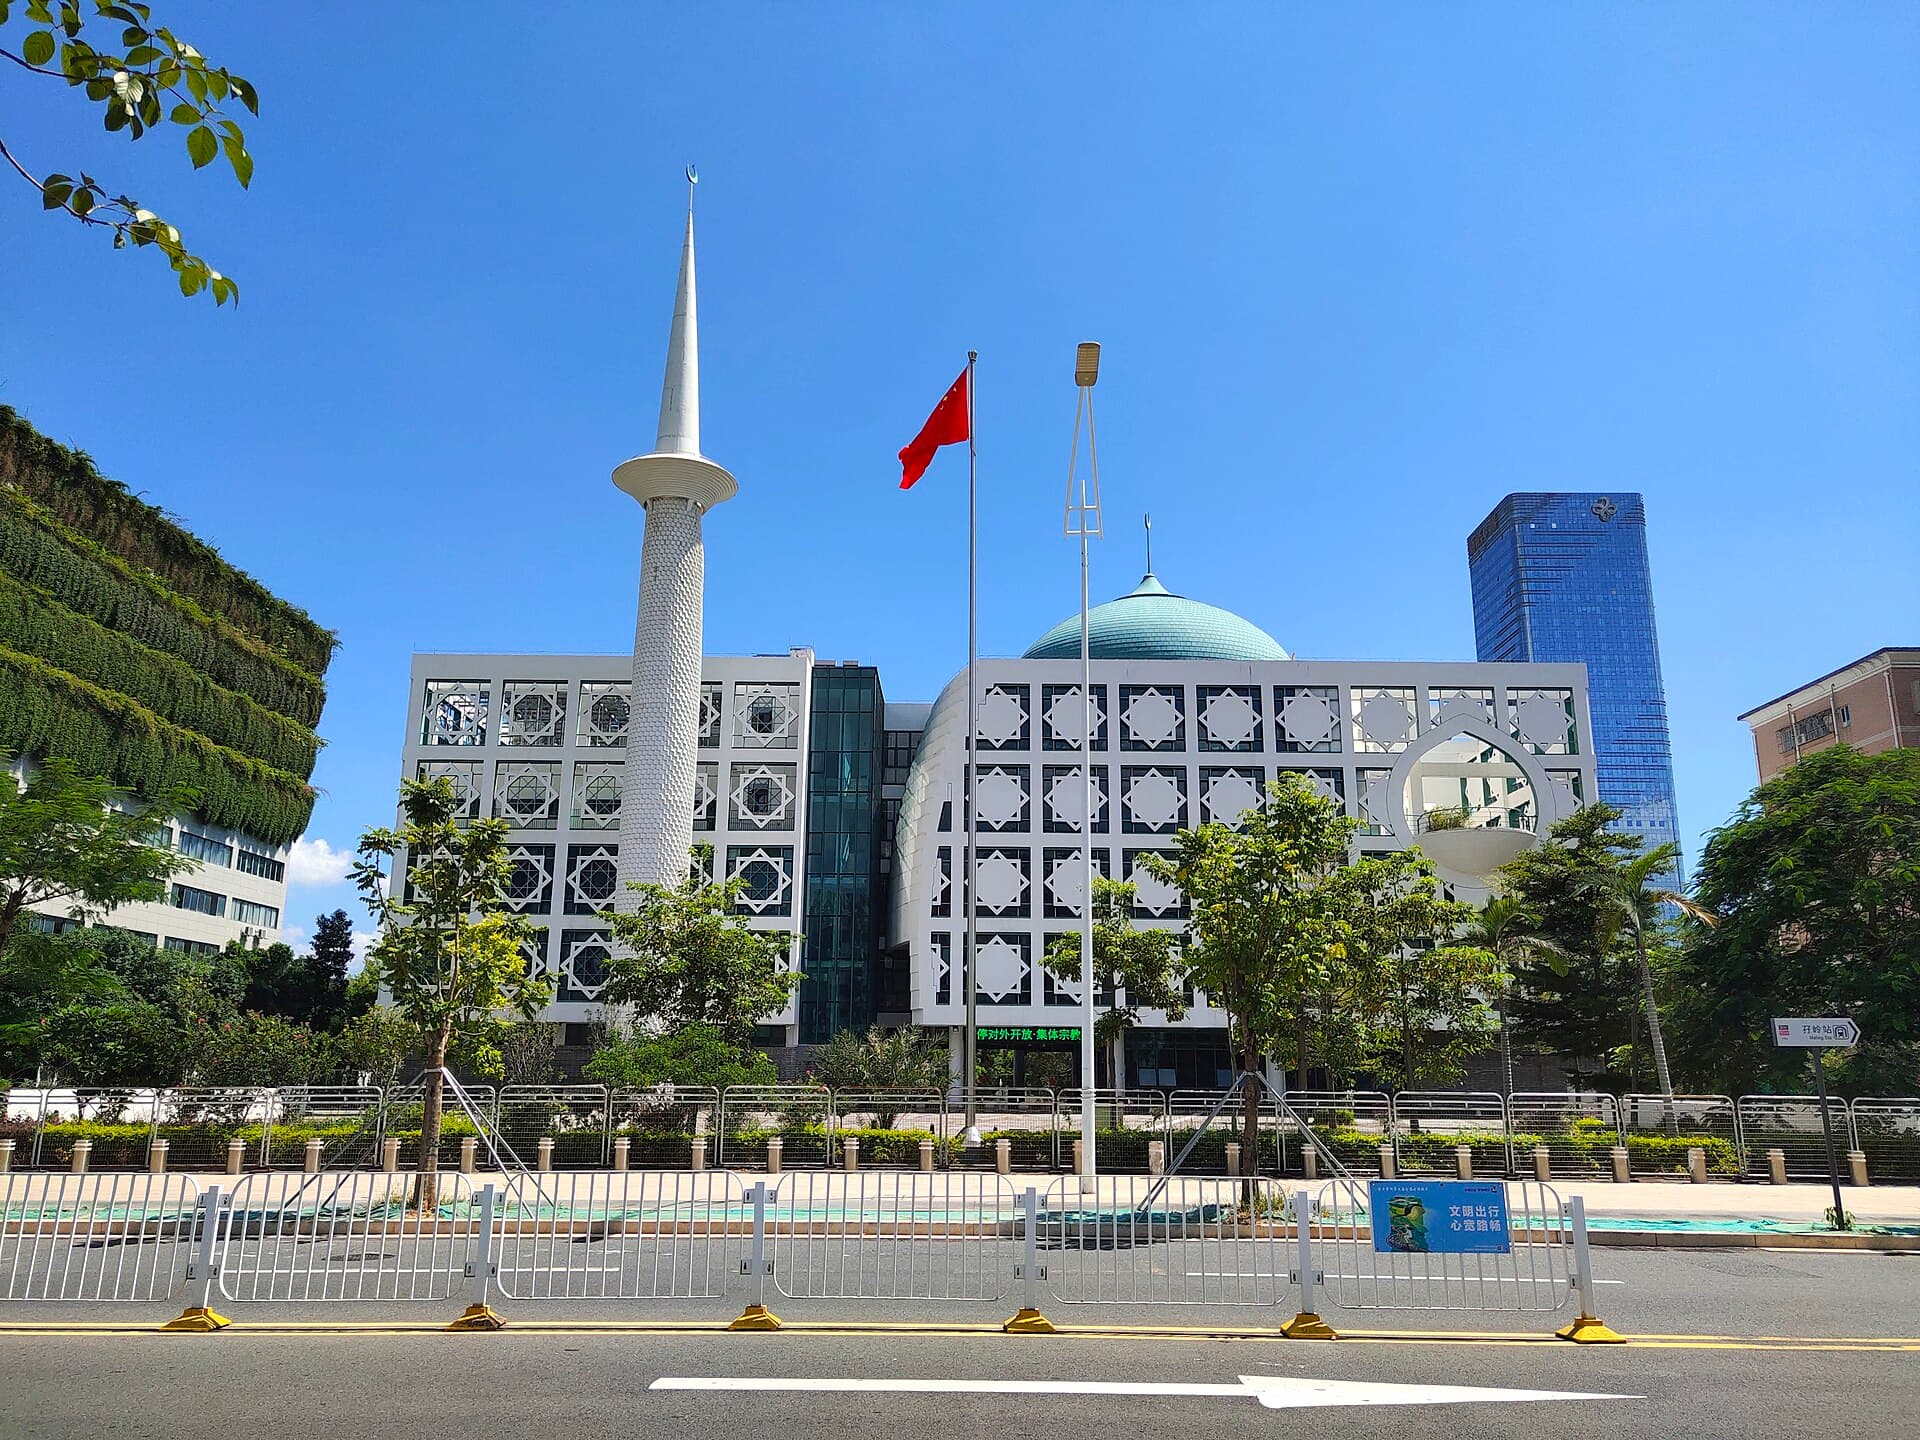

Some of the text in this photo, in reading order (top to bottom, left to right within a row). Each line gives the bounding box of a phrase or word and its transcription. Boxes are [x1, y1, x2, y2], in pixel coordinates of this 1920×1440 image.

[1449, 1205, 1500, 1218] 文明出行
[1450, 1219, 1502, 1232] 心宽路畅
